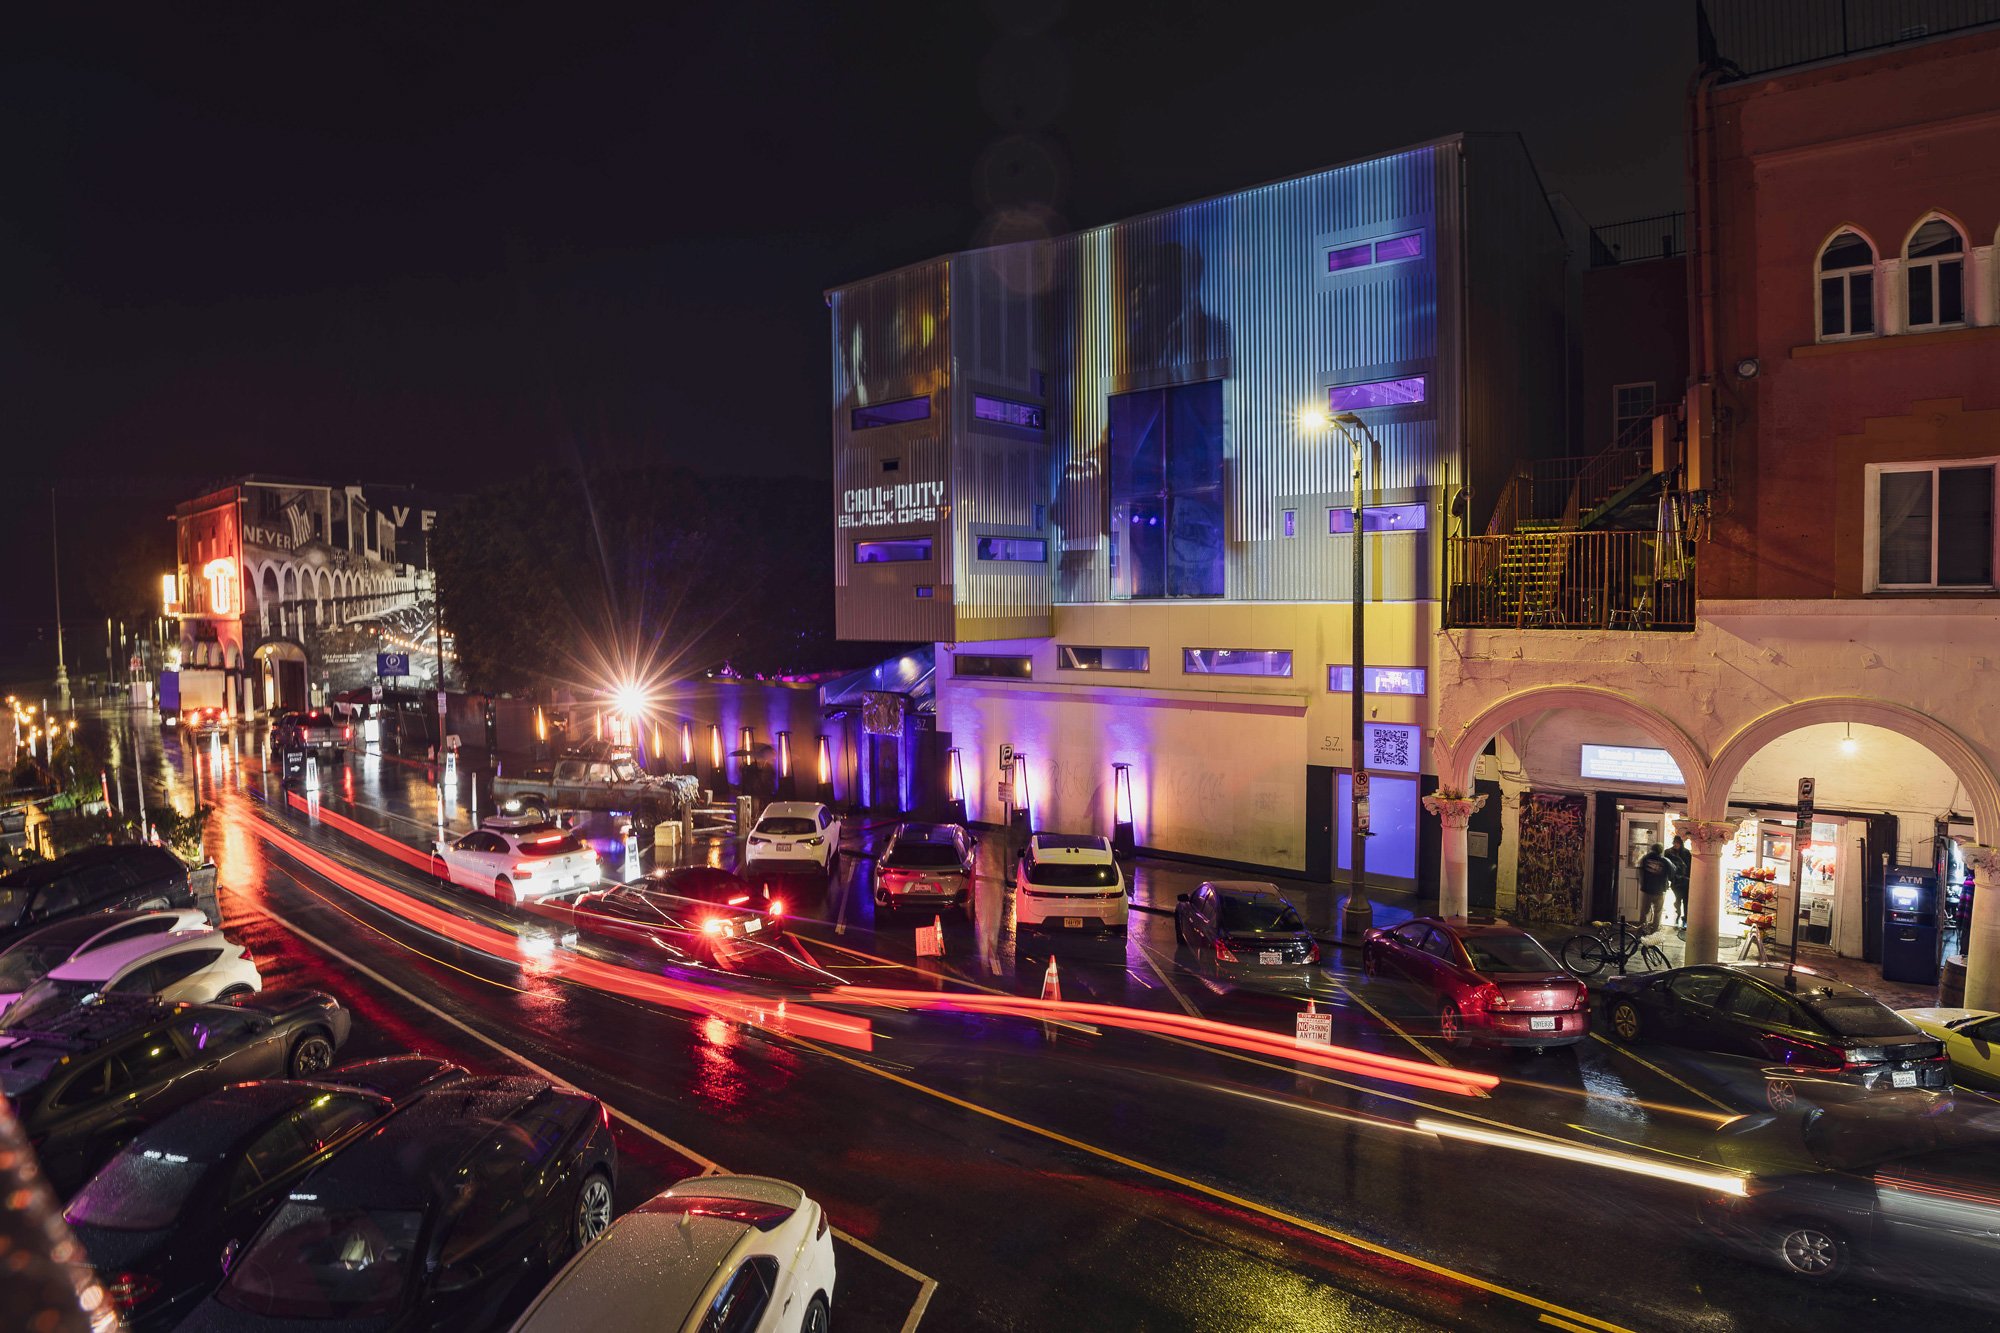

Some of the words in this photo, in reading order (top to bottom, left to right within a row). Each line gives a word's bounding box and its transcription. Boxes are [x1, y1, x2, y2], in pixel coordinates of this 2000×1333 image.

[844, 486, 885, 513] CALL
[894, 481, 944, 509] DUTY
[838, 510, 894, 528] BLACK
[897, 505, 936, 524] OPS
[243, 524, 291, 550] NEVER
[1325, 735, 1340, 747] 57
[1898, 875, 1923, 885] ATM
[1298, 1022, 1308, 1031] NO
[1309, 1023, 1329, 1033] PARKING
[1300, 1032, 1327, 1040] ANYTIME
